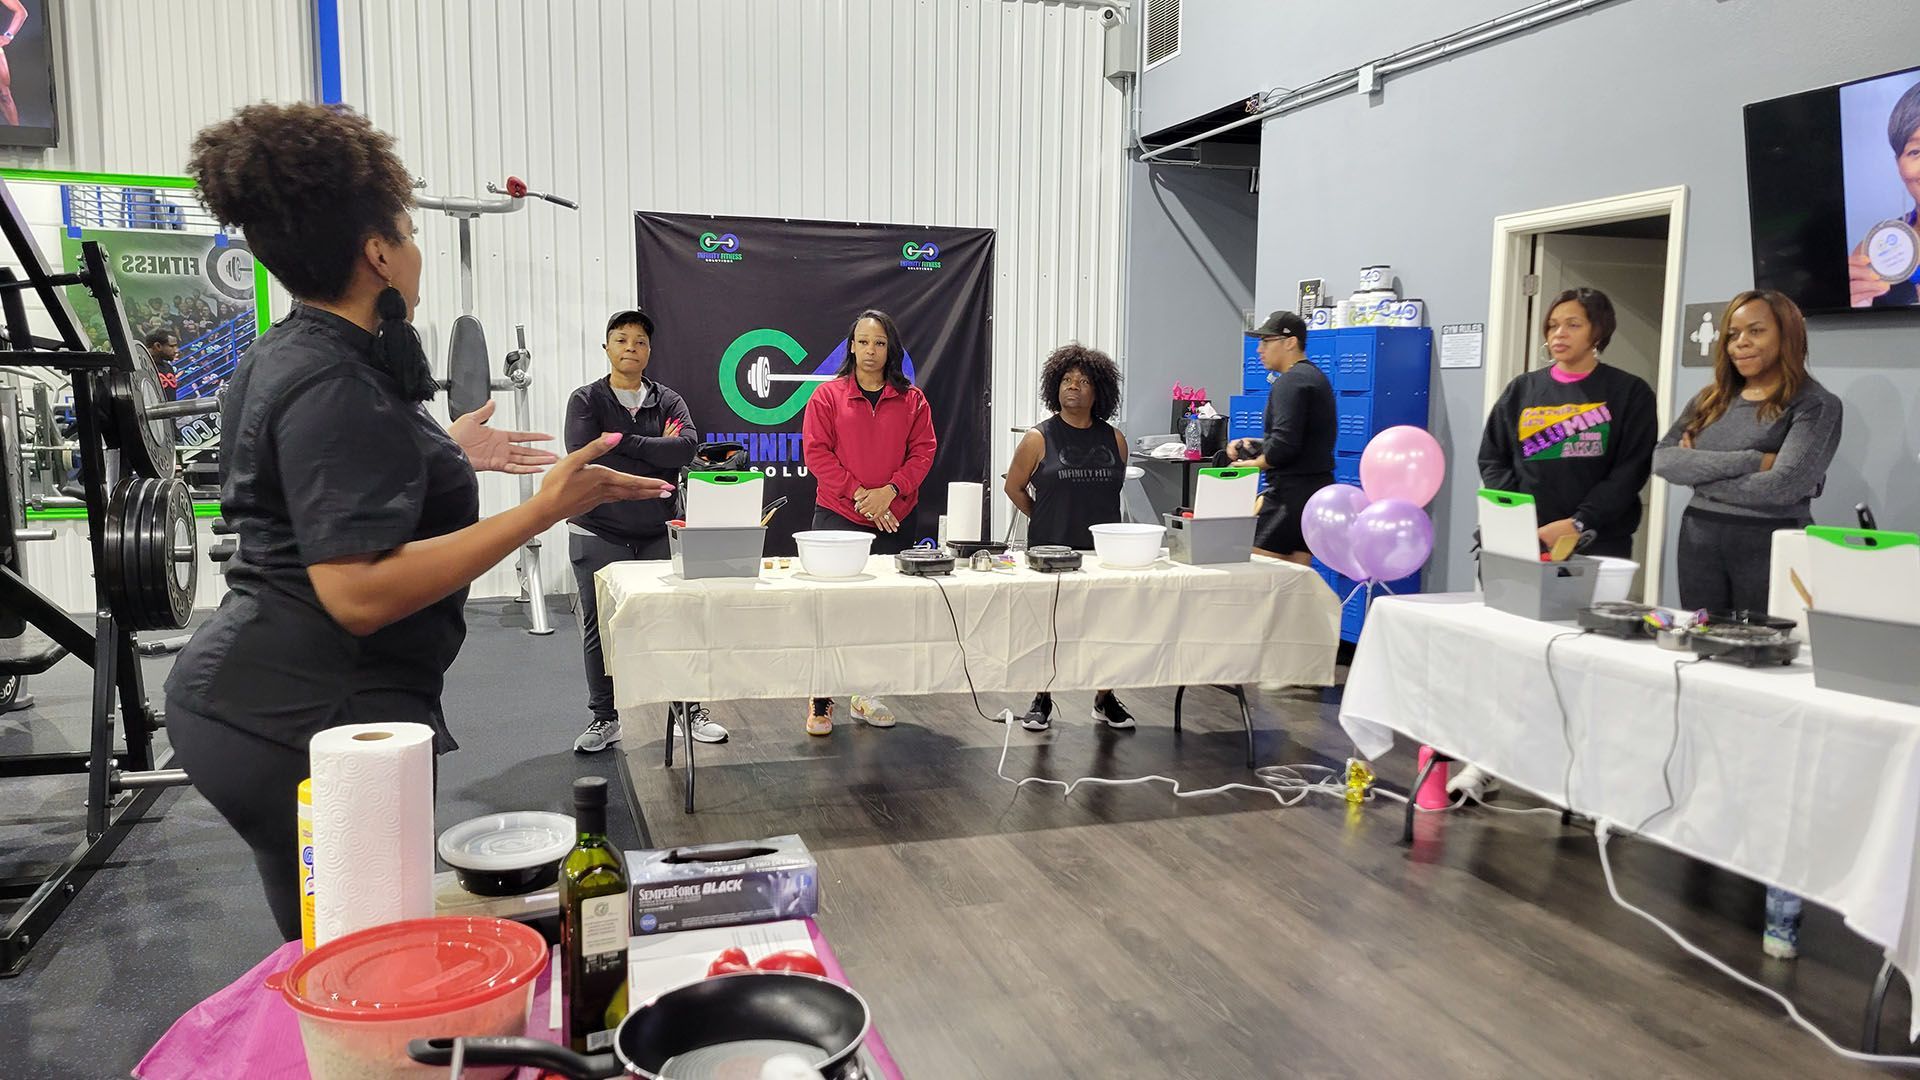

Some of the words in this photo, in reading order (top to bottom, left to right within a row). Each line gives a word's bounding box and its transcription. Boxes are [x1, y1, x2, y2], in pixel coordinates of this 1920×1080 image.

[1459, 323, 1483, 333] RULES
[1522, 405, 1613, 458] ALUMNI
[705, 432, 804, 462] FINIT
[1560, 441, 1604, 458] AKA
[1058, 469, 1093, 479] INFINITY
[701, 878, 744, 896] BLACK
